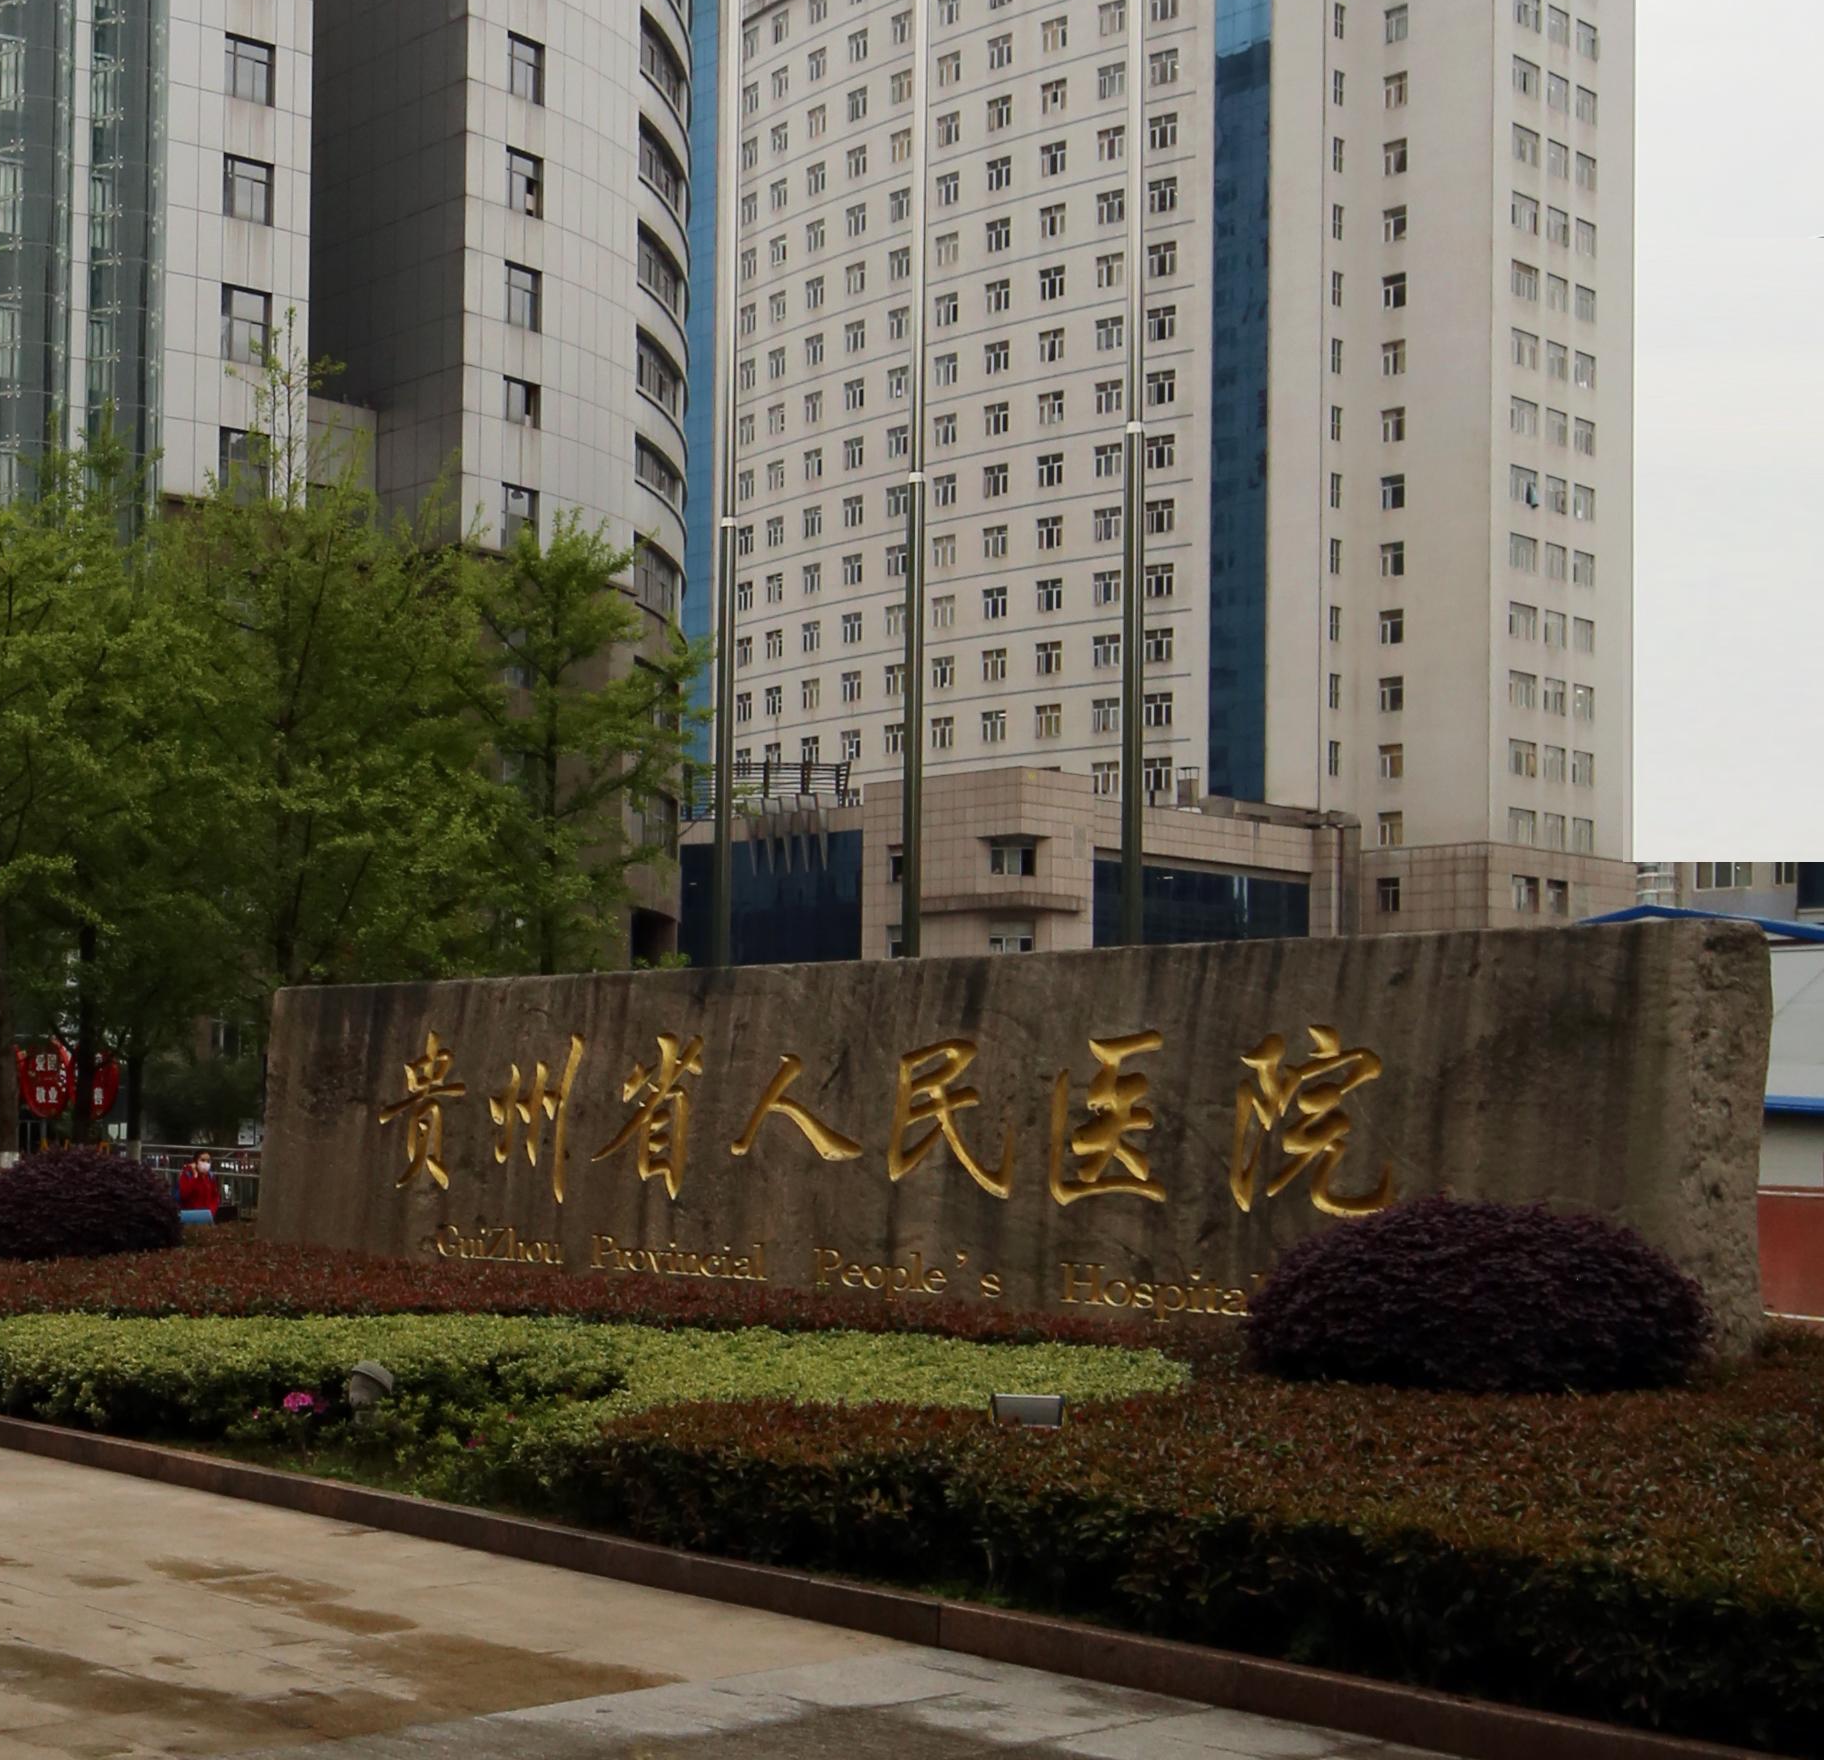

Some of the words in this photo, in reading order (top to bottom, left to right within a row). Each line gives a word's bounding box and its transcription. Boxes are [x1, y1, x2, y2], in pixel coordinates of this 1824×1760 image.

[378, 1024, 1395, 1218] 贵州省人民医院
[436, 1224, 564, 1265] GuiZhou
[589, 1233, 768, 1281] Provincial
